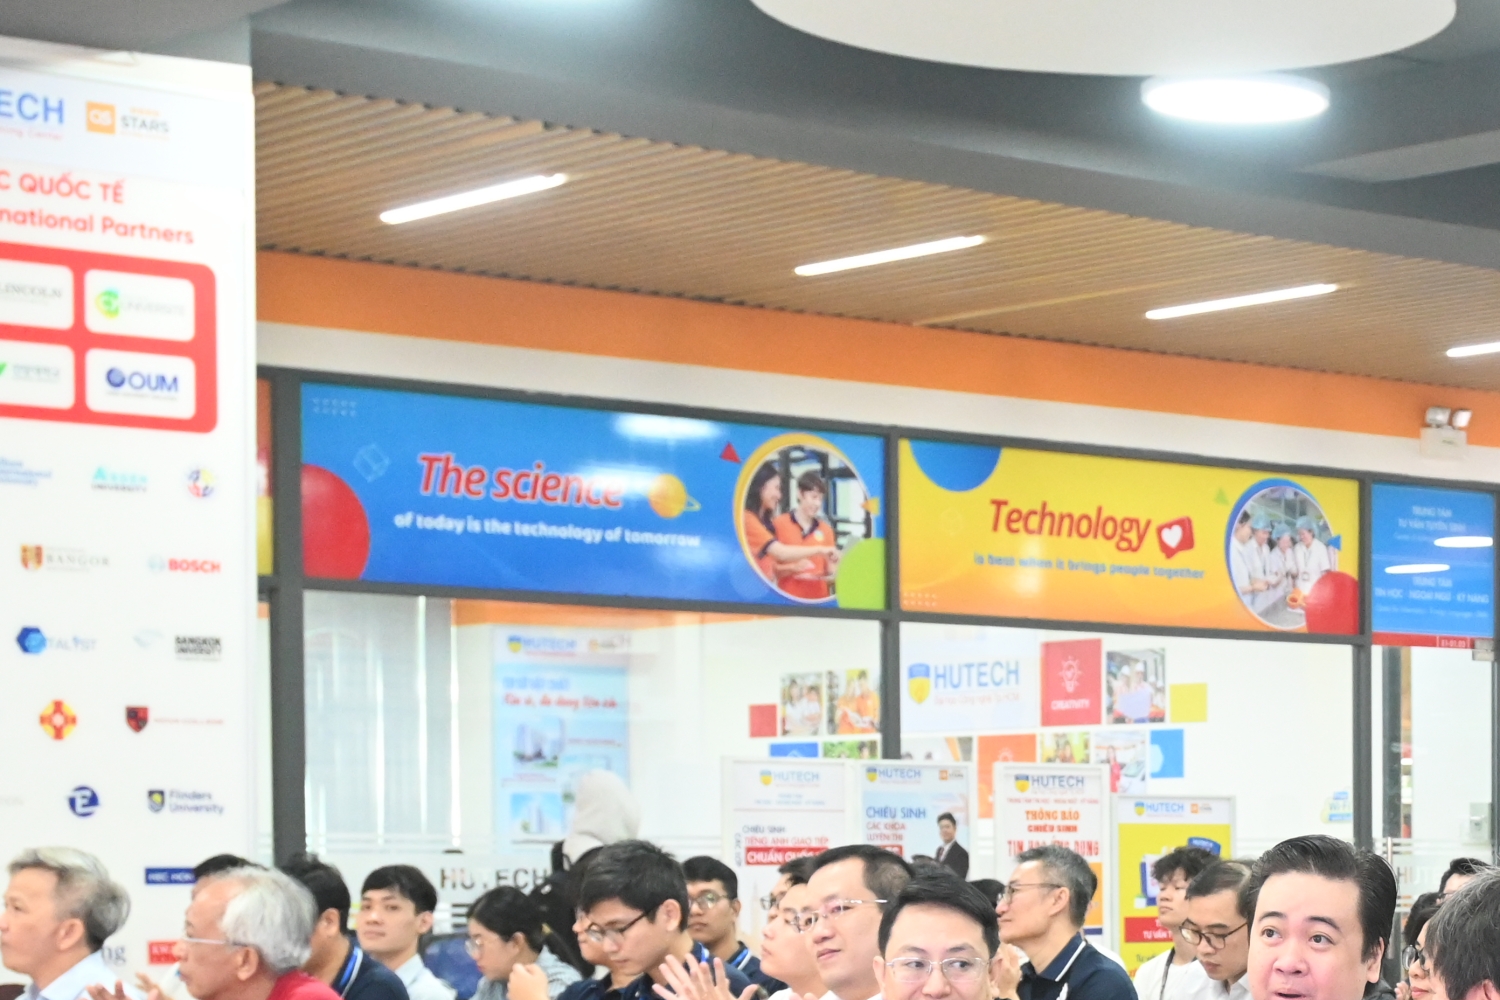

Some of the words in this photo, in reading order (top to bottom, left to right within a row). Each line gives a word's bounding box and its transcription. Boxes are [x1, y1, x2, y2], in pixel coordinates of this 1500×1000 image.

[121, 115, 169, 133] STARS
[19, 172, 91, 199] QUỐC
[99, 178, 126, 203] TẾ
[101, 215, 195, 245] Partners
[128, 371, 178, 393] OUM
[419, 453, 487, 499] The
[492, 461, 624, 508] science
[394, 511, 415, 528] of
[416, 514, 465, 535] today
[467, 515, 482, 533] is
[484, 517, 513, 536] the
[514, 521, 602, 544] technology
[604, 526, 624, 543] of
[624, 529, 701, 547] tomorrow
[990, 499, 1152, 552] Technology
[168, 557, 221, 573] BOSCH
[988, 553, 1016, 567] best
[1067, 559, 1107, 575] brings
[1110, 562, 1150, 577] people
[1153, 566, 1205, 580] together
[934, 661, 1020, 690] HUTECH
[773, 771, 820, 782] HUTECH
[878, 768, 921, 779] HUTECH
[1031, 775, 1085, 788] HUTECH
[169, 789, 213, 801] Flinders
[169, 803, 224, 816] University
[900, 806, 927, 819] SINH
[1025, 807, 1058, 821] THÔNG
[1060, 807, 1080, 821] BÁO
[1146, 802, 1184, 813] HUTECH
[1057, 824, 1078, 833] SINH
[440, 866, 548, 891] HUECH
